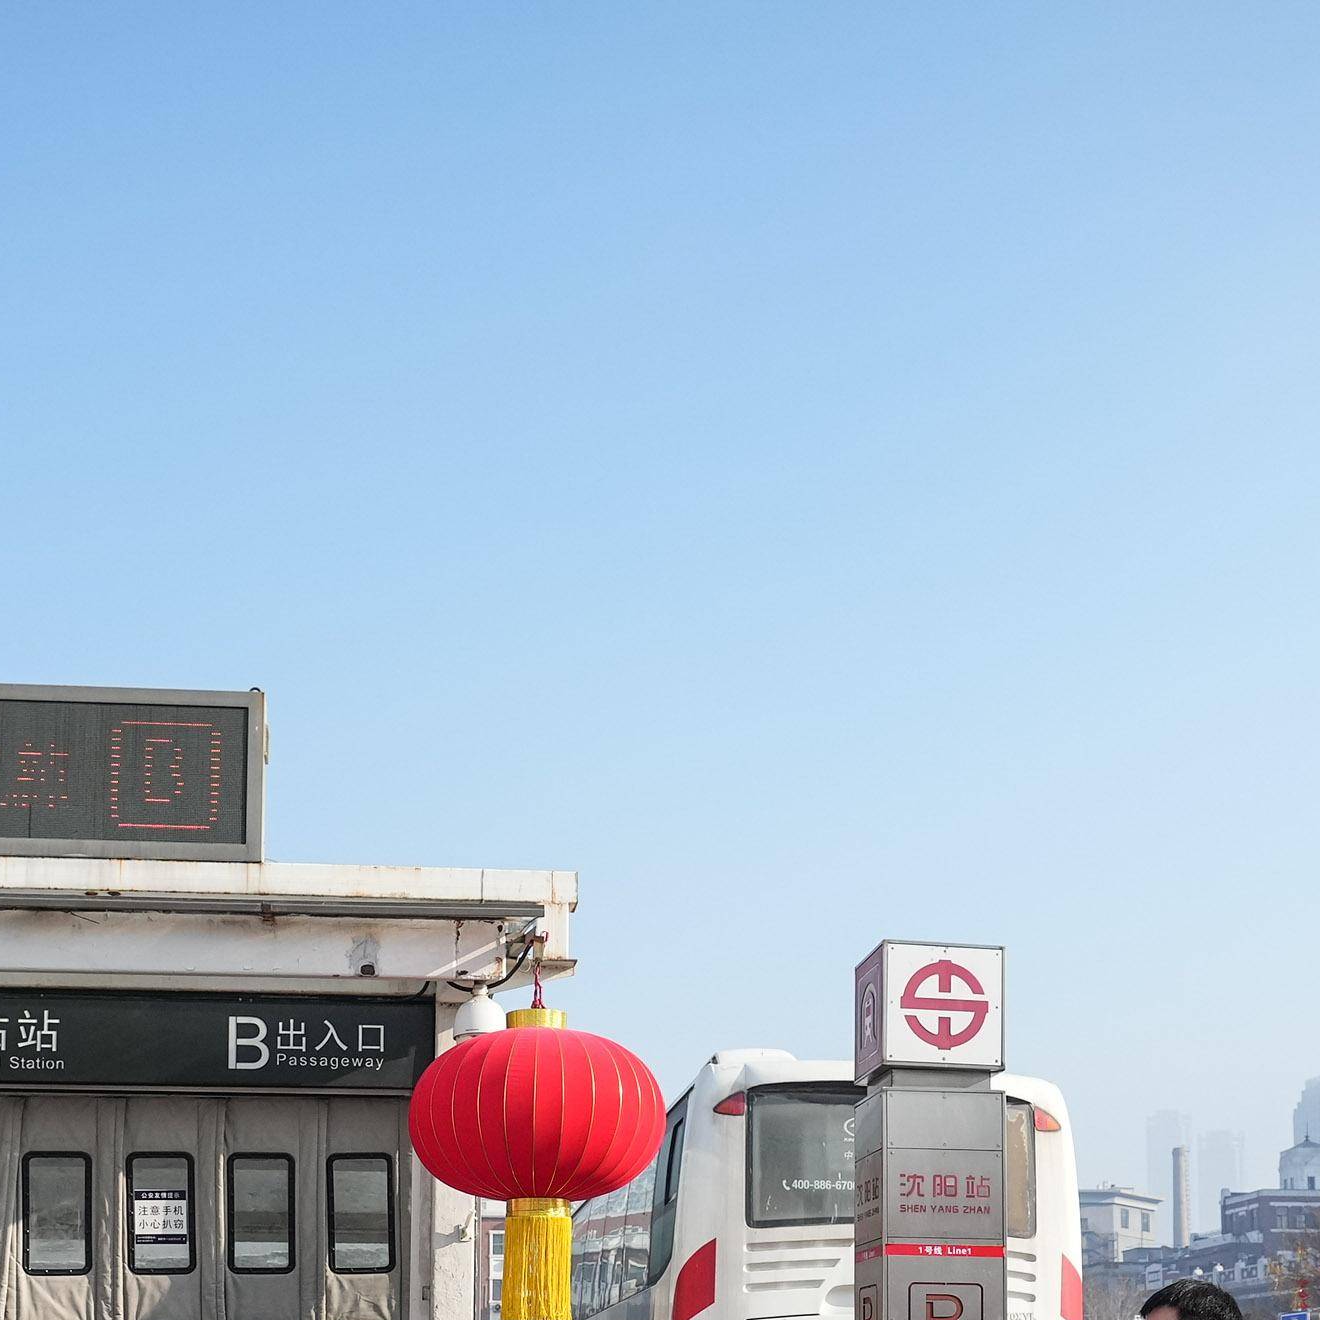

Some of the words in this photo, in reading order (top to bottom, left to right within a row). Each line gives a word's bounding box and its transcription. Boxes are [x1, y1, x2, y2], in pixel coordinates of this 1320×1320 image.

[276, 1018, 386, 1053] 出入口
[228, 1015, 271, 1071] B
[9, 1055, 66, 1071] Station
[275, 1052, 385, 1072] Passageway
[791, 1179, 855, 1191] 400-886-670
[899, 1173, 991, 1199] 沈阳站
[138, 1205, 184, 1216] 注意手机
[899, 1204, 927, 1214] SHEN
[930, 1205, 960, 1214] YANG
[962, 1205, 991, 1215] ZHAN
[139, 1218, 185, 1230] 小心扒窃
[918, 1246, 943, 1256] 1号线
[947, 1246, 972, 1256] Line1
